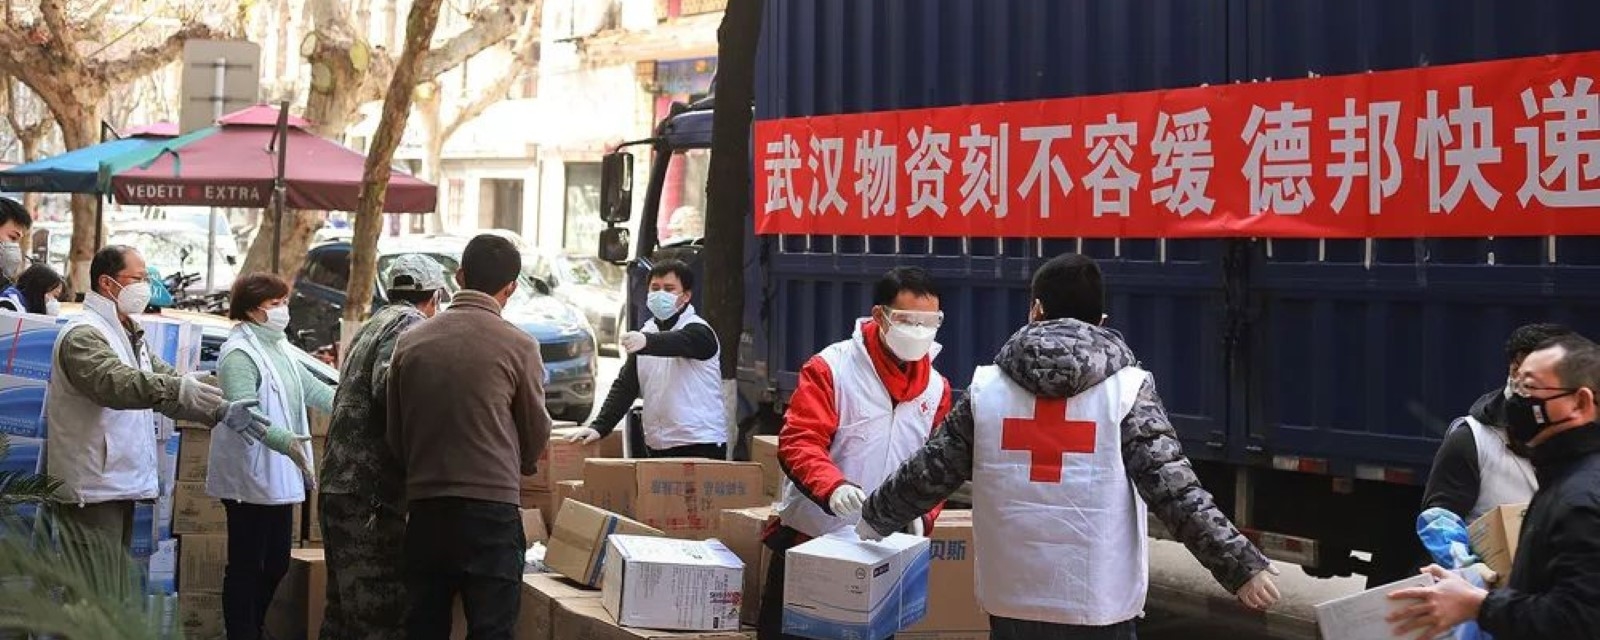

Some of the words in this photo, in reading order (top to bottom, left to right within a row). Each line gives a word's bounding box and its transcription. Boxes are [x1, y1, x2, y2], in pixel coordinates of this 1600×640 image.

[764, 108, 1216, 219] 武汉物资刻不容缓
[1240, 77, 1600, 216] 德邦快递
[126, 184, 185, 198] VEDETT
[205, 186, 260, 200] EXTRA
